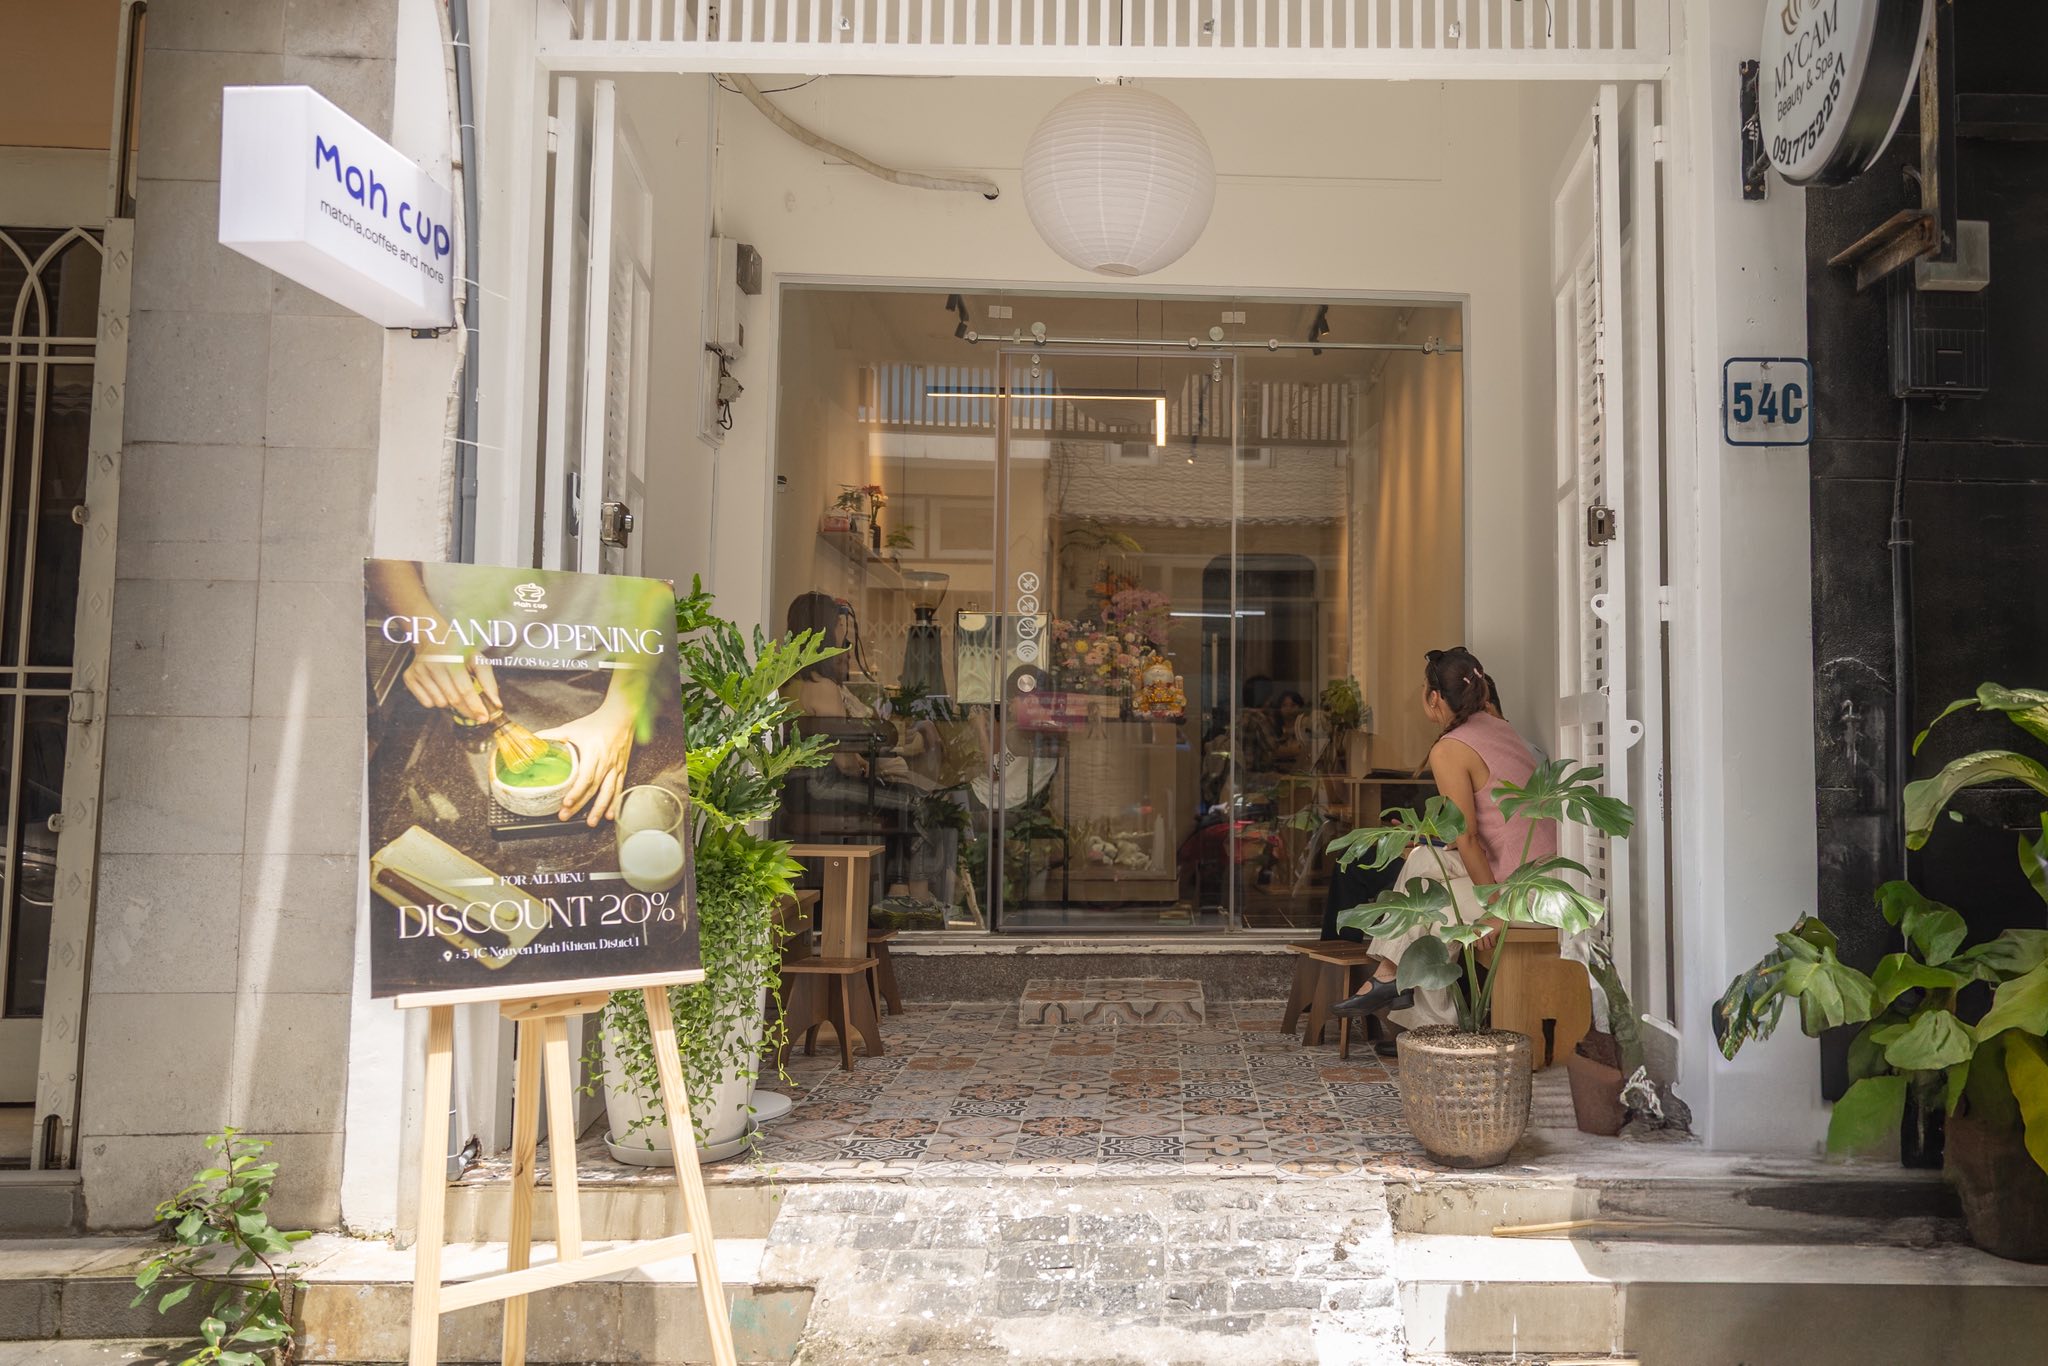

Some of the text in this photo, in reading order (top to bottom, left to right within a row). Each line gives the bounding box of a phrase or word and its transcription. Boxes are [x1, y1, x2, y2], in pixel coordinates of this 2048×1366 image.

[1774, 0, 1837, 97] MYCAM
[1777, 51, 1833, 122] Beauty & Spa
[1773, 52, 1846, 165] 0917752257
[315, 135, 450, 260] Mah cup
[400, 249, 418, 269] and
[420, 261, 444, 284] more
[1733, 382, 1803, 424] 54C
[383, 615, 664, 655] GRAND OPENING
[475, 655, 502, 666] From
[504, 656, 537, 667] 17/08
[538, 659, 549, 668] to
[500, 872, 585, 887] FOR ALL MENU
[399, 892, 675, 939] DISCOUNT 20%
[490, 945, 532, 960] Nguyen
[534, 942, 560, 954] Binh
[600, 937, 634, 949] District
[635, 936, 639, 947] 1
